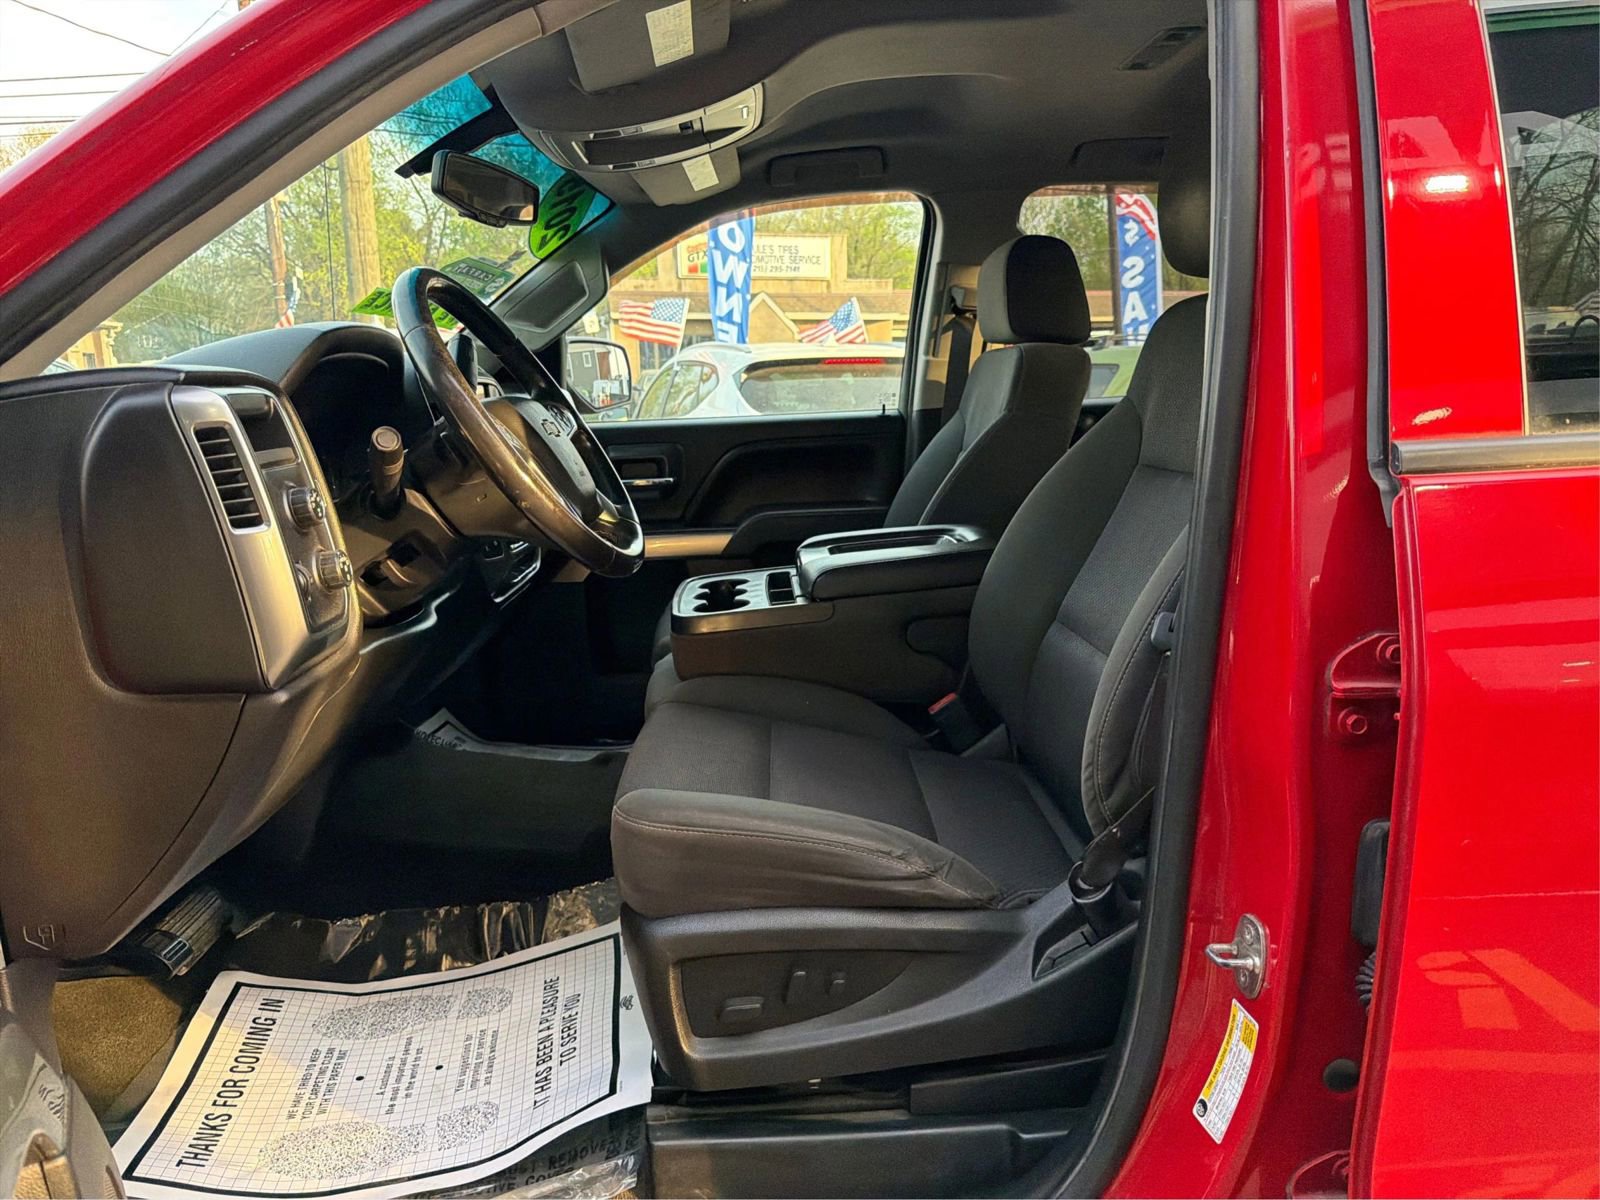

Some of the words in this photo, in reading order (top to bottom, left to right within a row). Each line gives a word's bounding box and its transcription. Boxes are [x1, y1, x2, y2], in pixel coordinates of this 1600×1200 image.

[789, 255, 822, 266] SERVICE
[258, 998, 285, 1013] IN
[540, 976, 560, 1025] PLEASURE
[564, 993, 581, 1013] YOU
[538, 1023, 555, 1033] A
[561, 1011, 579, 1047] SERVE
[229, 1016, 277, 1074] COMING
[402, 1036, 413, 1056] person
[477, 1028, 487, 1050] service
[309, 1048, 322, 1063] KEEP
[335, 1049, 348, 1061] MAT
[536, 1033, 553, 1067] BEEN
[560, 1046, 577, 1066] TO
[304, 1063, 317, 1072] TO
[459, 1043, 472, 1077] suggestions
[328, 1061, 344, 1081] PAPER
[379, 1063, 393, 1090] customer
[394, 1056, 408, 1084] important
[409, 1063, 420, 1080] world
[297, 1072, 313, 1091] TRIED
[300, 1101, 316, 1121] YOUR
[308, 1066, 329, 1100] CARPETING
[321, 1047, 336, 1066] CLEAN
[322, 1082, 337, 1098] THIS
[405, 1080, 416, 1091] the
[454, 1078, 466, 1093] Your
[534, 1066, 552, 1096] HAS
[211, 1078, 250, 1107] FOR
[290, 1092, 305, 1108] HAVE
[390, 1086, 401, 1102] most
[316, 1098, 332, 1116] WITH
[385, 1103, 396, 1115] the
[533, 1095, 551, 1110] IT
[286, 1109, 299, 1120] WE
[175, 1112, 233, 1168] THANKS
